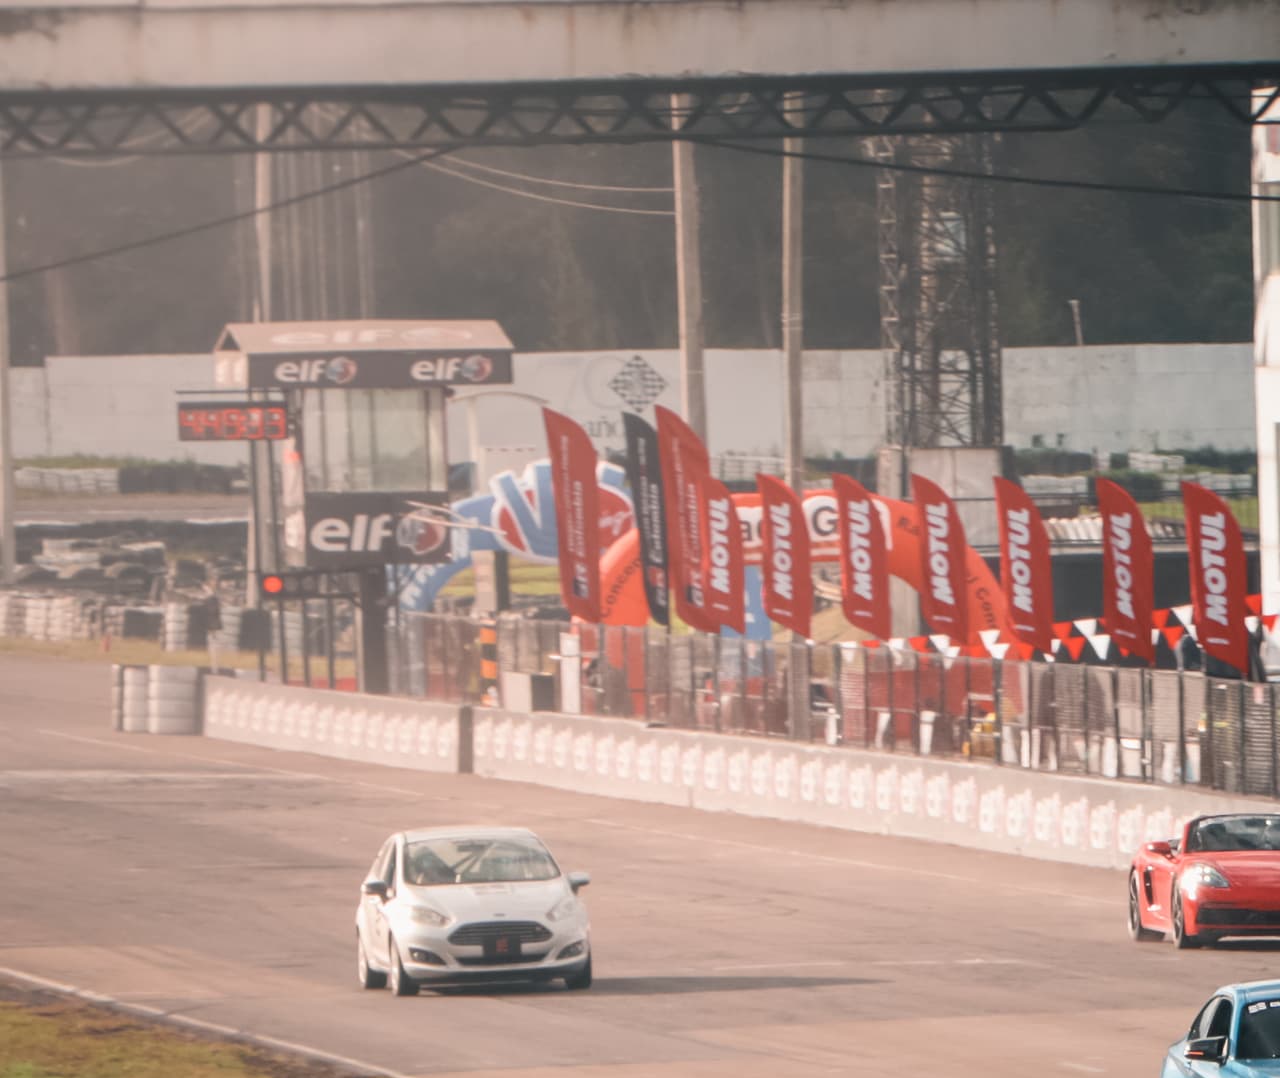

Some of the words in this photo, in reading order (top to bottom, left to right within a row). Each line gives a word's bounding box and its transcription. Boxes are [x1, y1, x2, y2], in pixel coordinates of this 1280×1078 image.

[275, 357, 326, 382] elf
[411, 356, 461, 381] elf
[310, 514, 393, 552] elf
[709, 497, 730, 594] MOTUL
[770, 502, 793, 600] MOTUL
[848, 499, 873, 600] MOTUL
[925, 502, 955, 605] MOTUL
[1007, 507, 1034, 613] MOTUL
[1109, 511, 1136, 620] MOTUL
[1200, 511, 1228, 626] MOTUL
